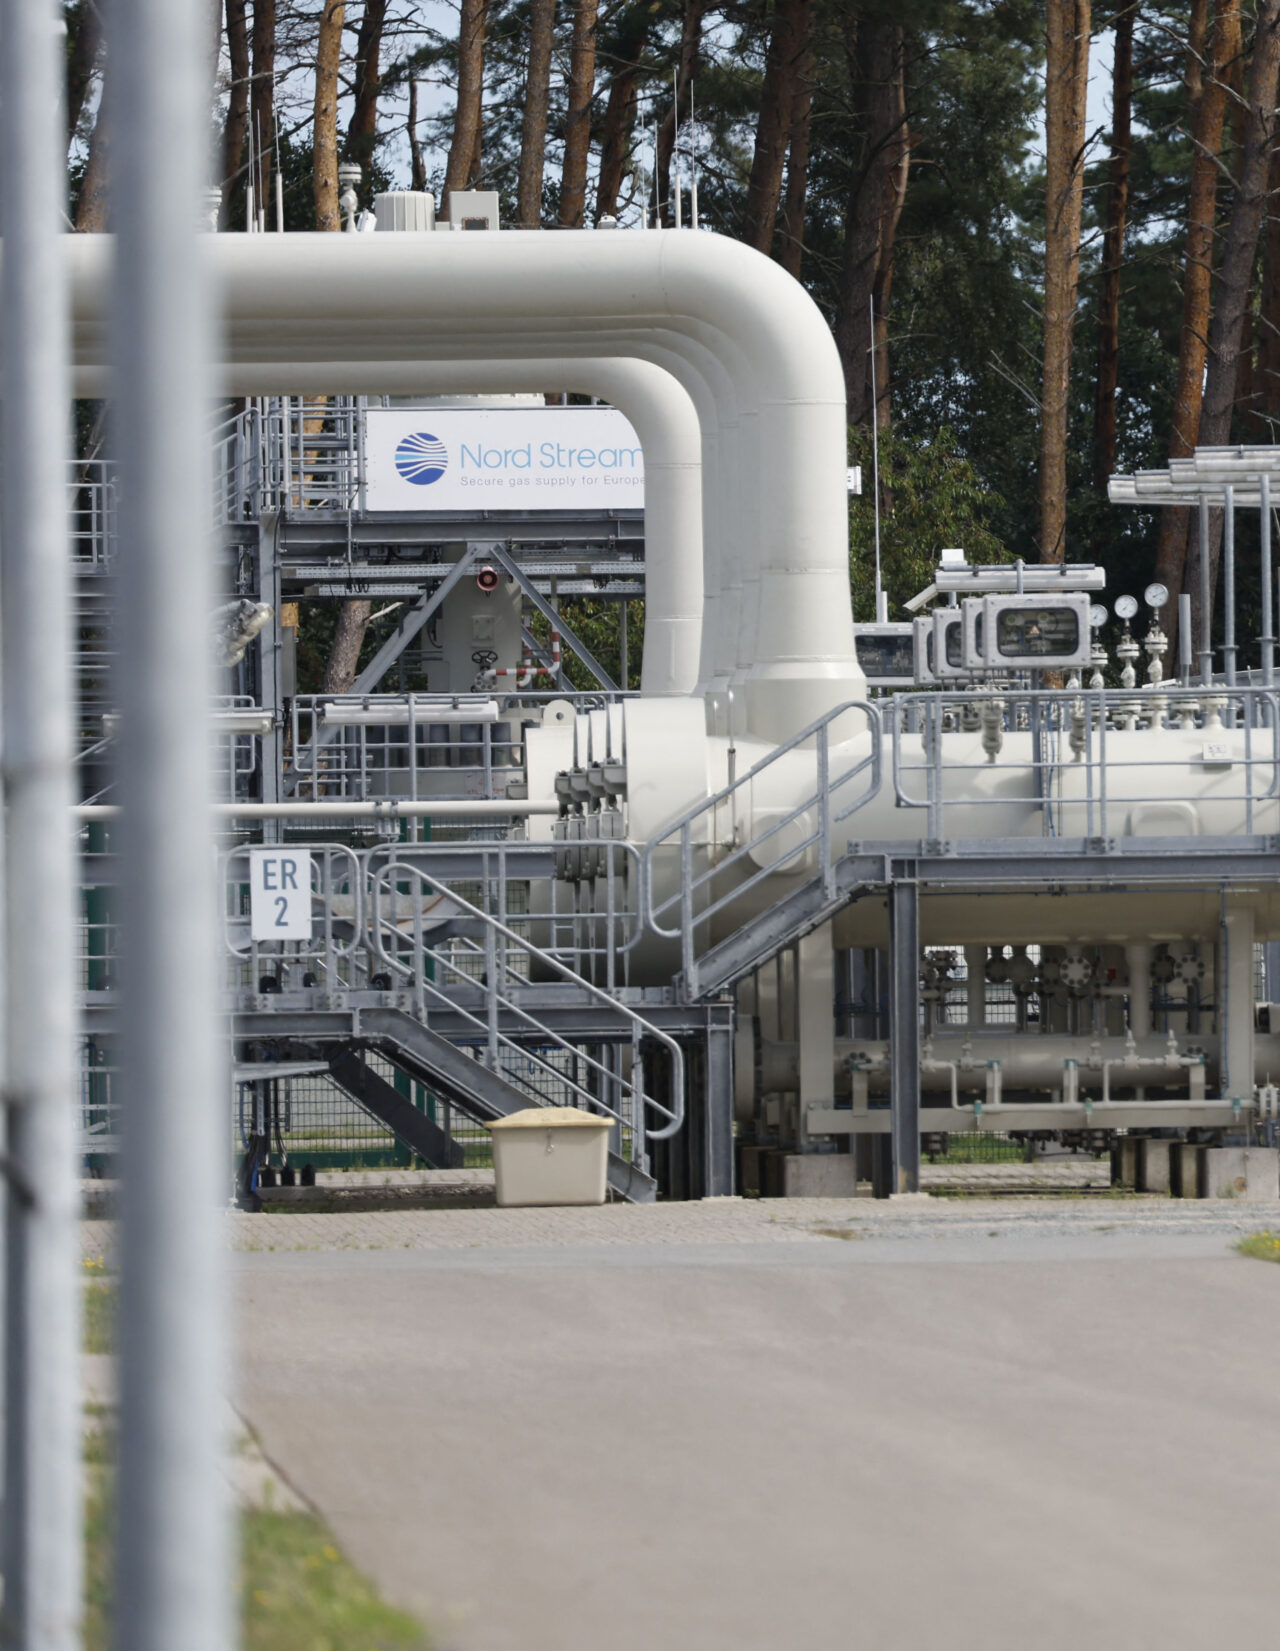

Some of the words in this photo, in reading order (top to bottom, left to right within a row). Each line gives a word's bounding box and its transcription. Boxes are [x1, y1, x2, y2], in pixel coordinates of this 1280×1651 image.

[461, 443, 531, 469] Nord
[539, 442, 644, 469] Stream
[460, 476, 504, 487] Secure
[509, 478, 530, 488] gas
[535, 477, 576, 488] supply
[582, 475, 598, 486] for
[263, 859, 298, 890] ER
[274, 896, 289, 926] 2
